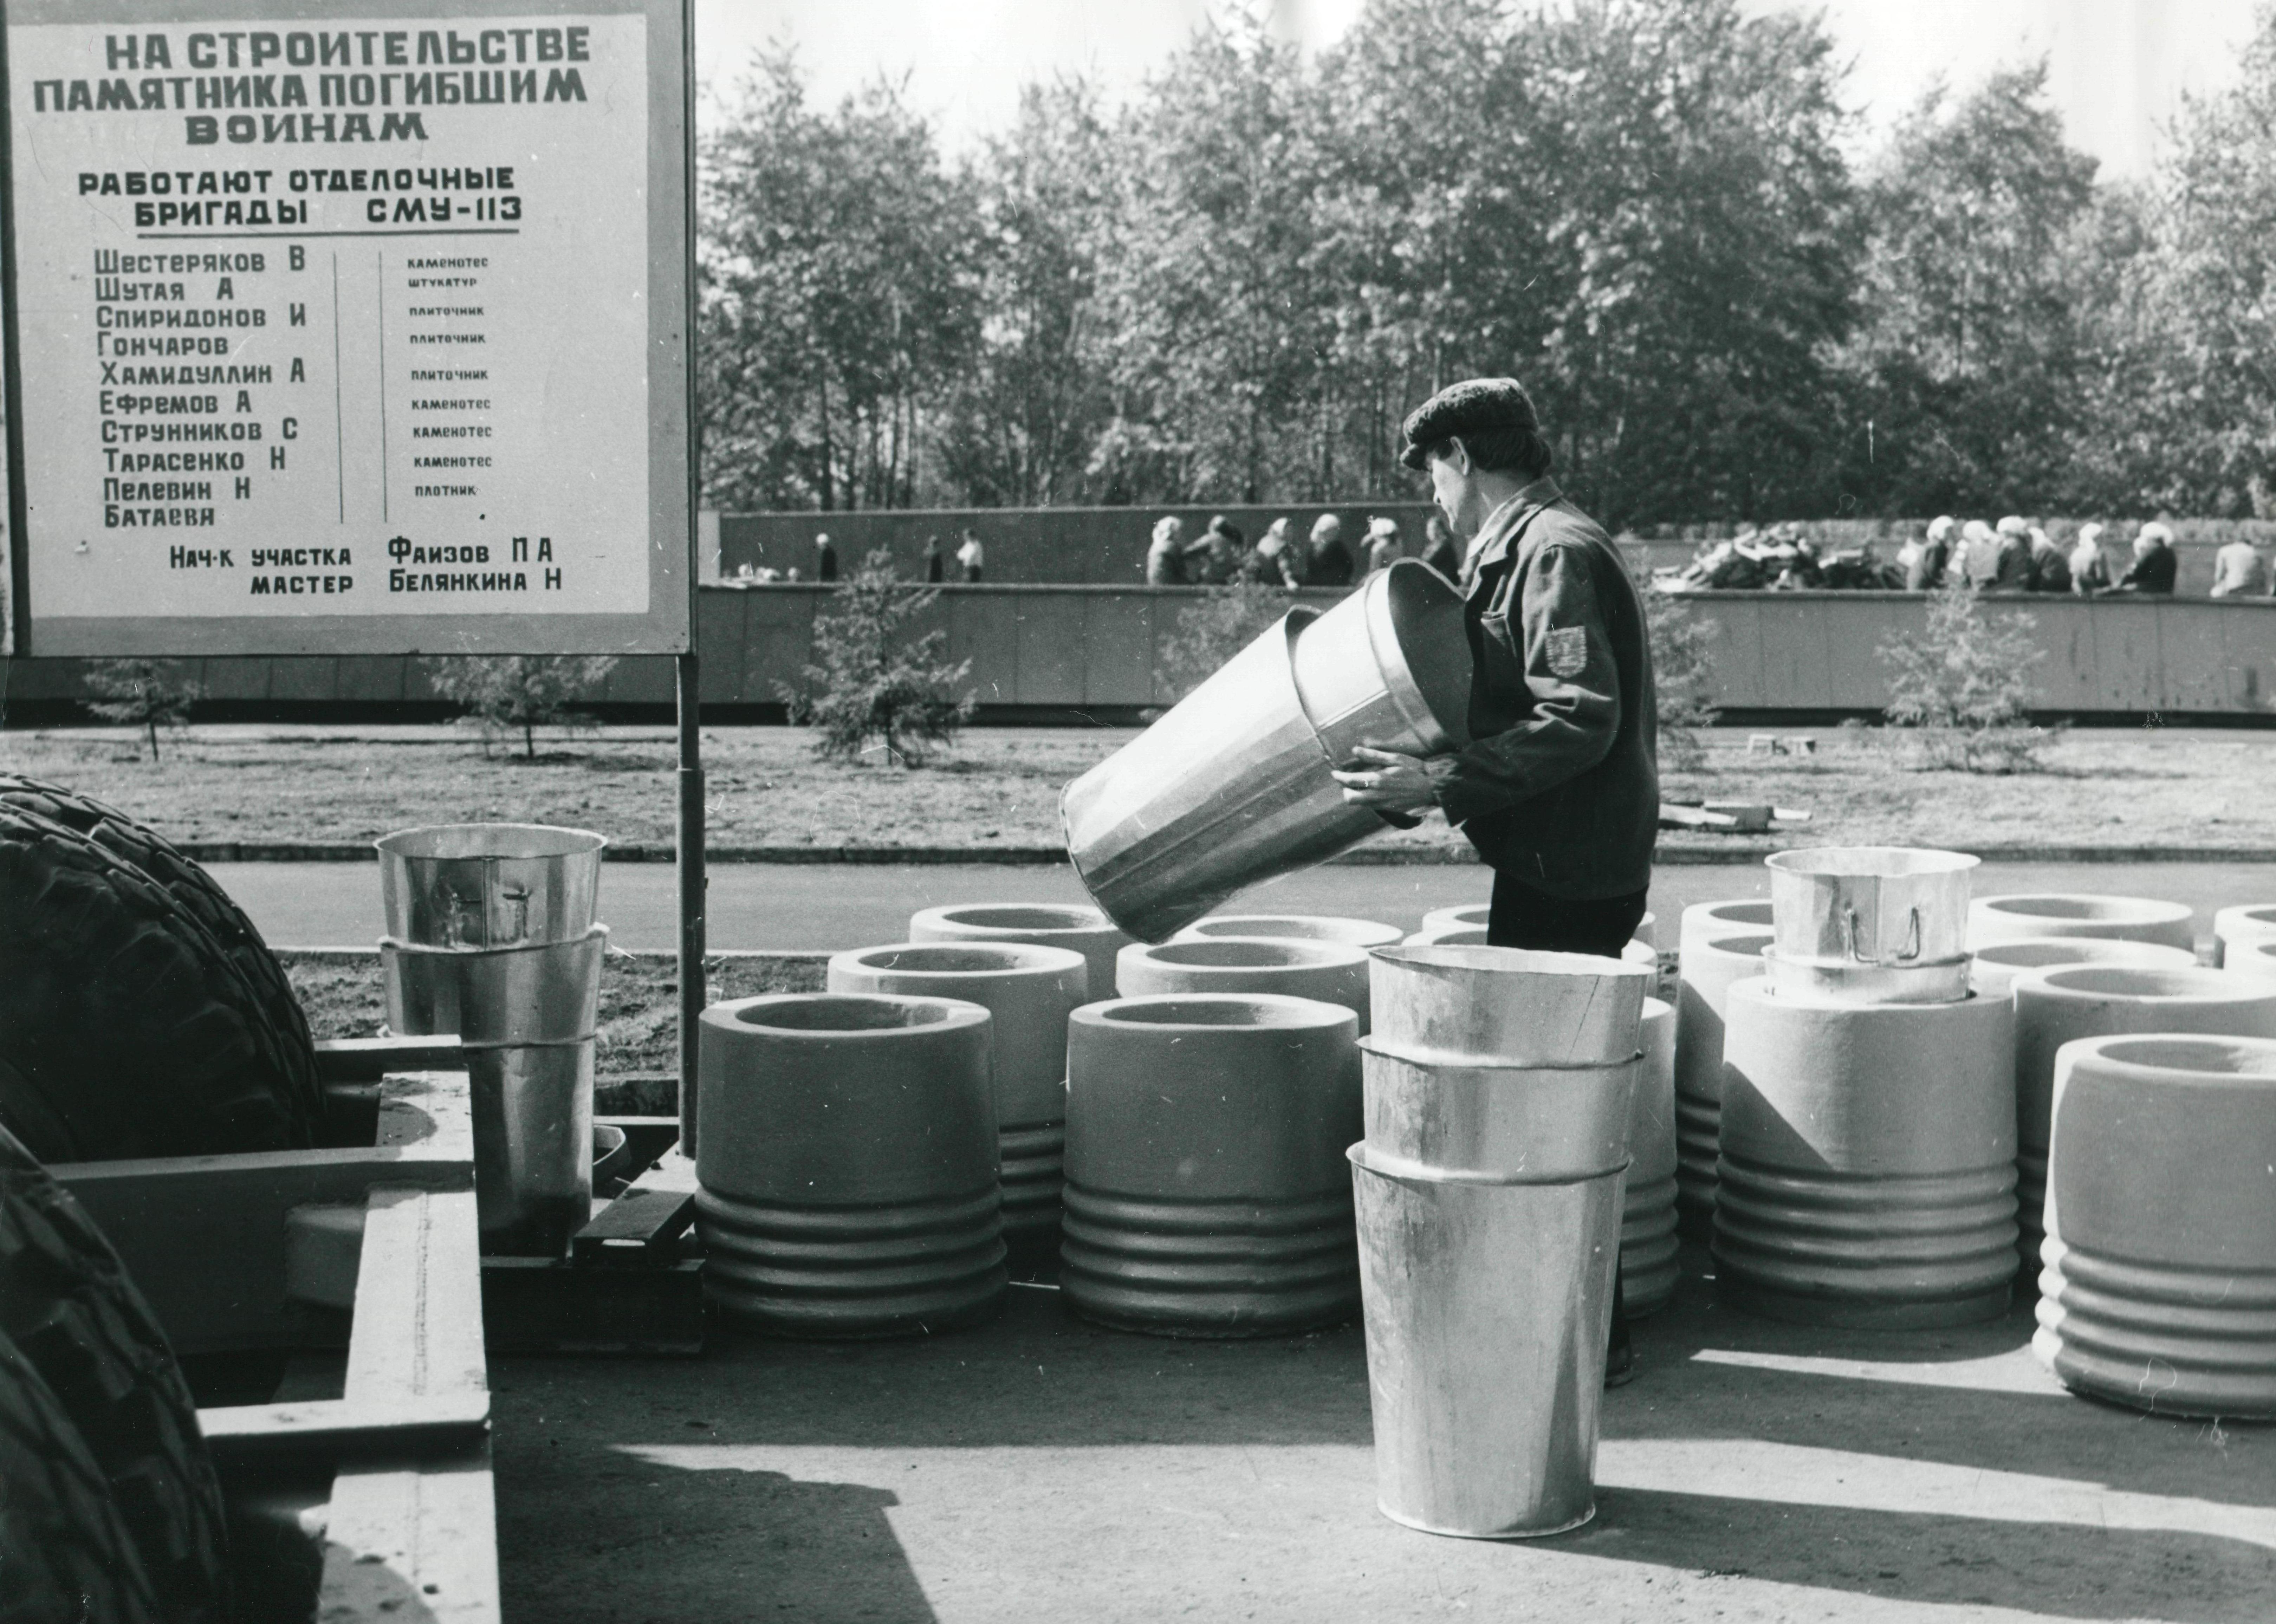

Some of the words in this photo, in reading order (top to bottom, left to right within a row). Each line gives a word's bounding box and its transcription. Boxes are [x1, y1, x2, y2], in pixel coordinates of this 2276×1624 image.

[106, 34, 172, 71] НА
[188, 26, 591, 69] СТРОИТЕЛЬСТВЕ
[32, 75, 308, 113] ПАМЯТНИКА
[320, 67, 588, 107] ПОГИБШИМ
[184, 111, 430, 146] ВОИНАМ
[77, 169, 273, 197] РАБОТАЮТ
[288, 166, 515, 194] ОТДЕЛОЧНЫЕ
[134, 198, 308, 228] БРИГАДЫ
[366, 195, 523, 224] СМУ-113
[288, 244, 306, 272] В
[216, 276, 235, 301] А
[289, 302, 307, 327] И
[289, 356, 306, 384] А
[235, 389, 253, 414] А
[281, 416, 299, 441] С
[269, 445, 286, 471] Н
[234, 476, 251, 500] Н
[511, 536, 529, 563] П
[536, 536, 553, 563] А
[544, 566, 562, 591] Н
